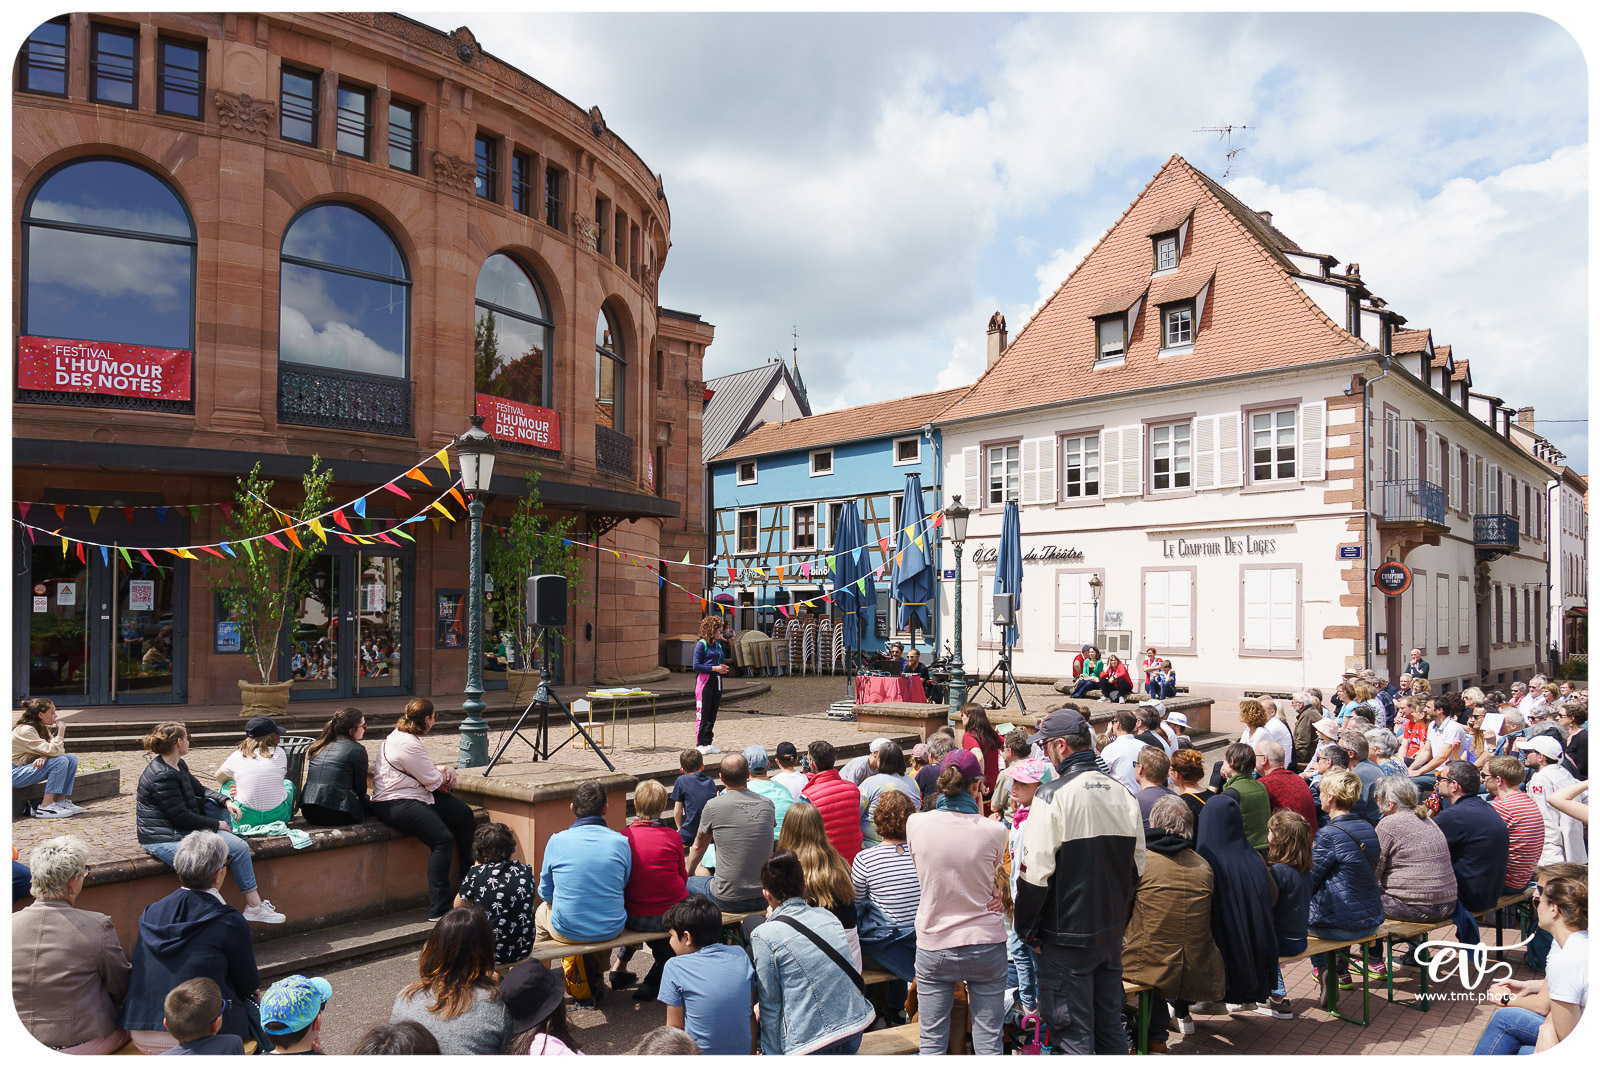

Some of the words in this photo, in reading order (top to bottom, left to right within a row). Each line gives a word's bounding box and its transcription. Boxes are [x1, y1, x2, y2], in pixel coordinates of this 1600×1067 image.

[55, 345, 114, 360] FESTIVAL
[55, 357, 163, 379] L'HUMOUR
[55, 372, 93, 386] DES
[98, 374, 162, 393] NOTES
[496, 402, 525, 417] FESTIVAL
[495, 423, 514, 437] DES
[517, 427, 549, 443] NOTES
[496, 413, 549, 433] L'HUMOUR
[1022, 548, 1038, 561] du
[1040, 545, 1084, 561] Théâtre
